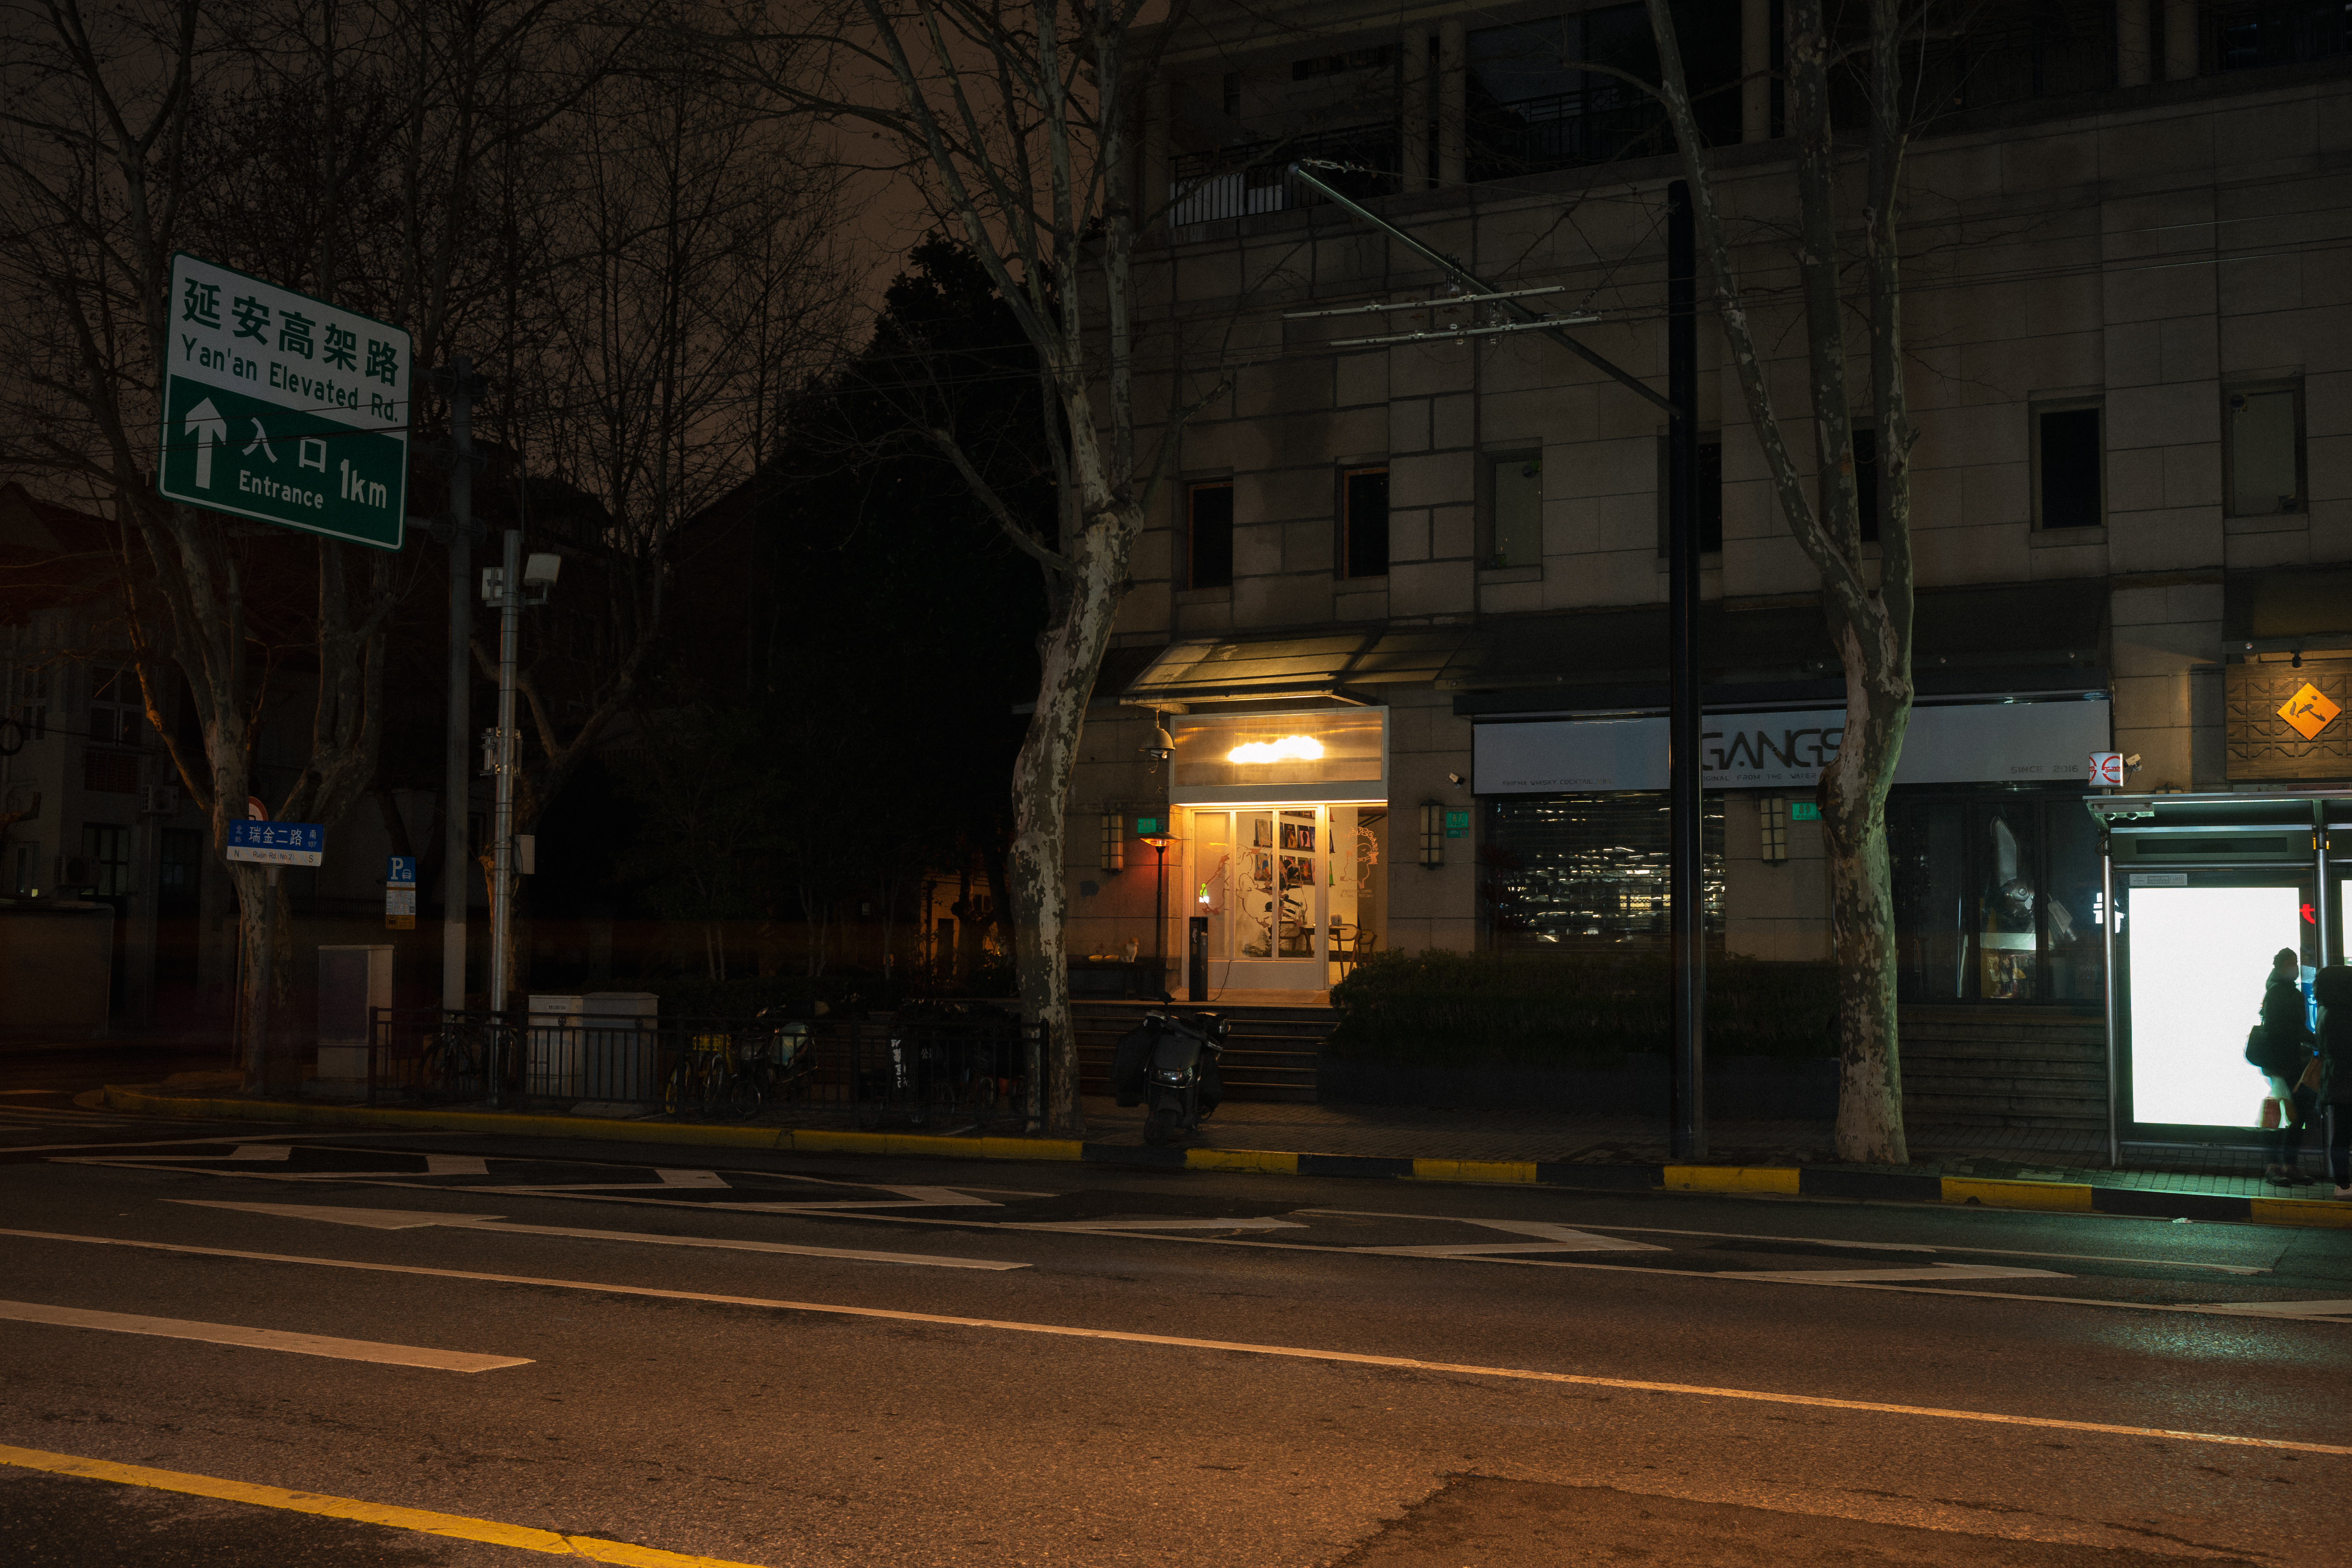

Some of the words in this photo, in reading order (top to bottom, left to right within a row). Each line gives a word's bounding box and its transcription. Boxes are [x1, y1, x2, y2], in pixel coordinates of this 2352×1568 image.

[181, 277, 399, 387] 延安高架路
[181, 333, 257, 381] Yan'an
[270, 361, 358, 410] Elevated
[371, 392, 398, 423] Rd.
[242, 417, 327, 473] 入口
[239, 470, 324, 509] Entrance
[340, 459, 387, 509] 1km
[1799, 805, 1810, 814] 89
[1452, 814, 1462, 822] 87
[235, 825, 242, 834] 北
[248, 826, 302, 847] 瑞金二路
[309, 829, 317, 839] 南
[234, 849, 240, 858] N
[253, 851, 267, 860] Ruijin
[309, 854, 314, 863] S
[390, 857, 404, 880] P
